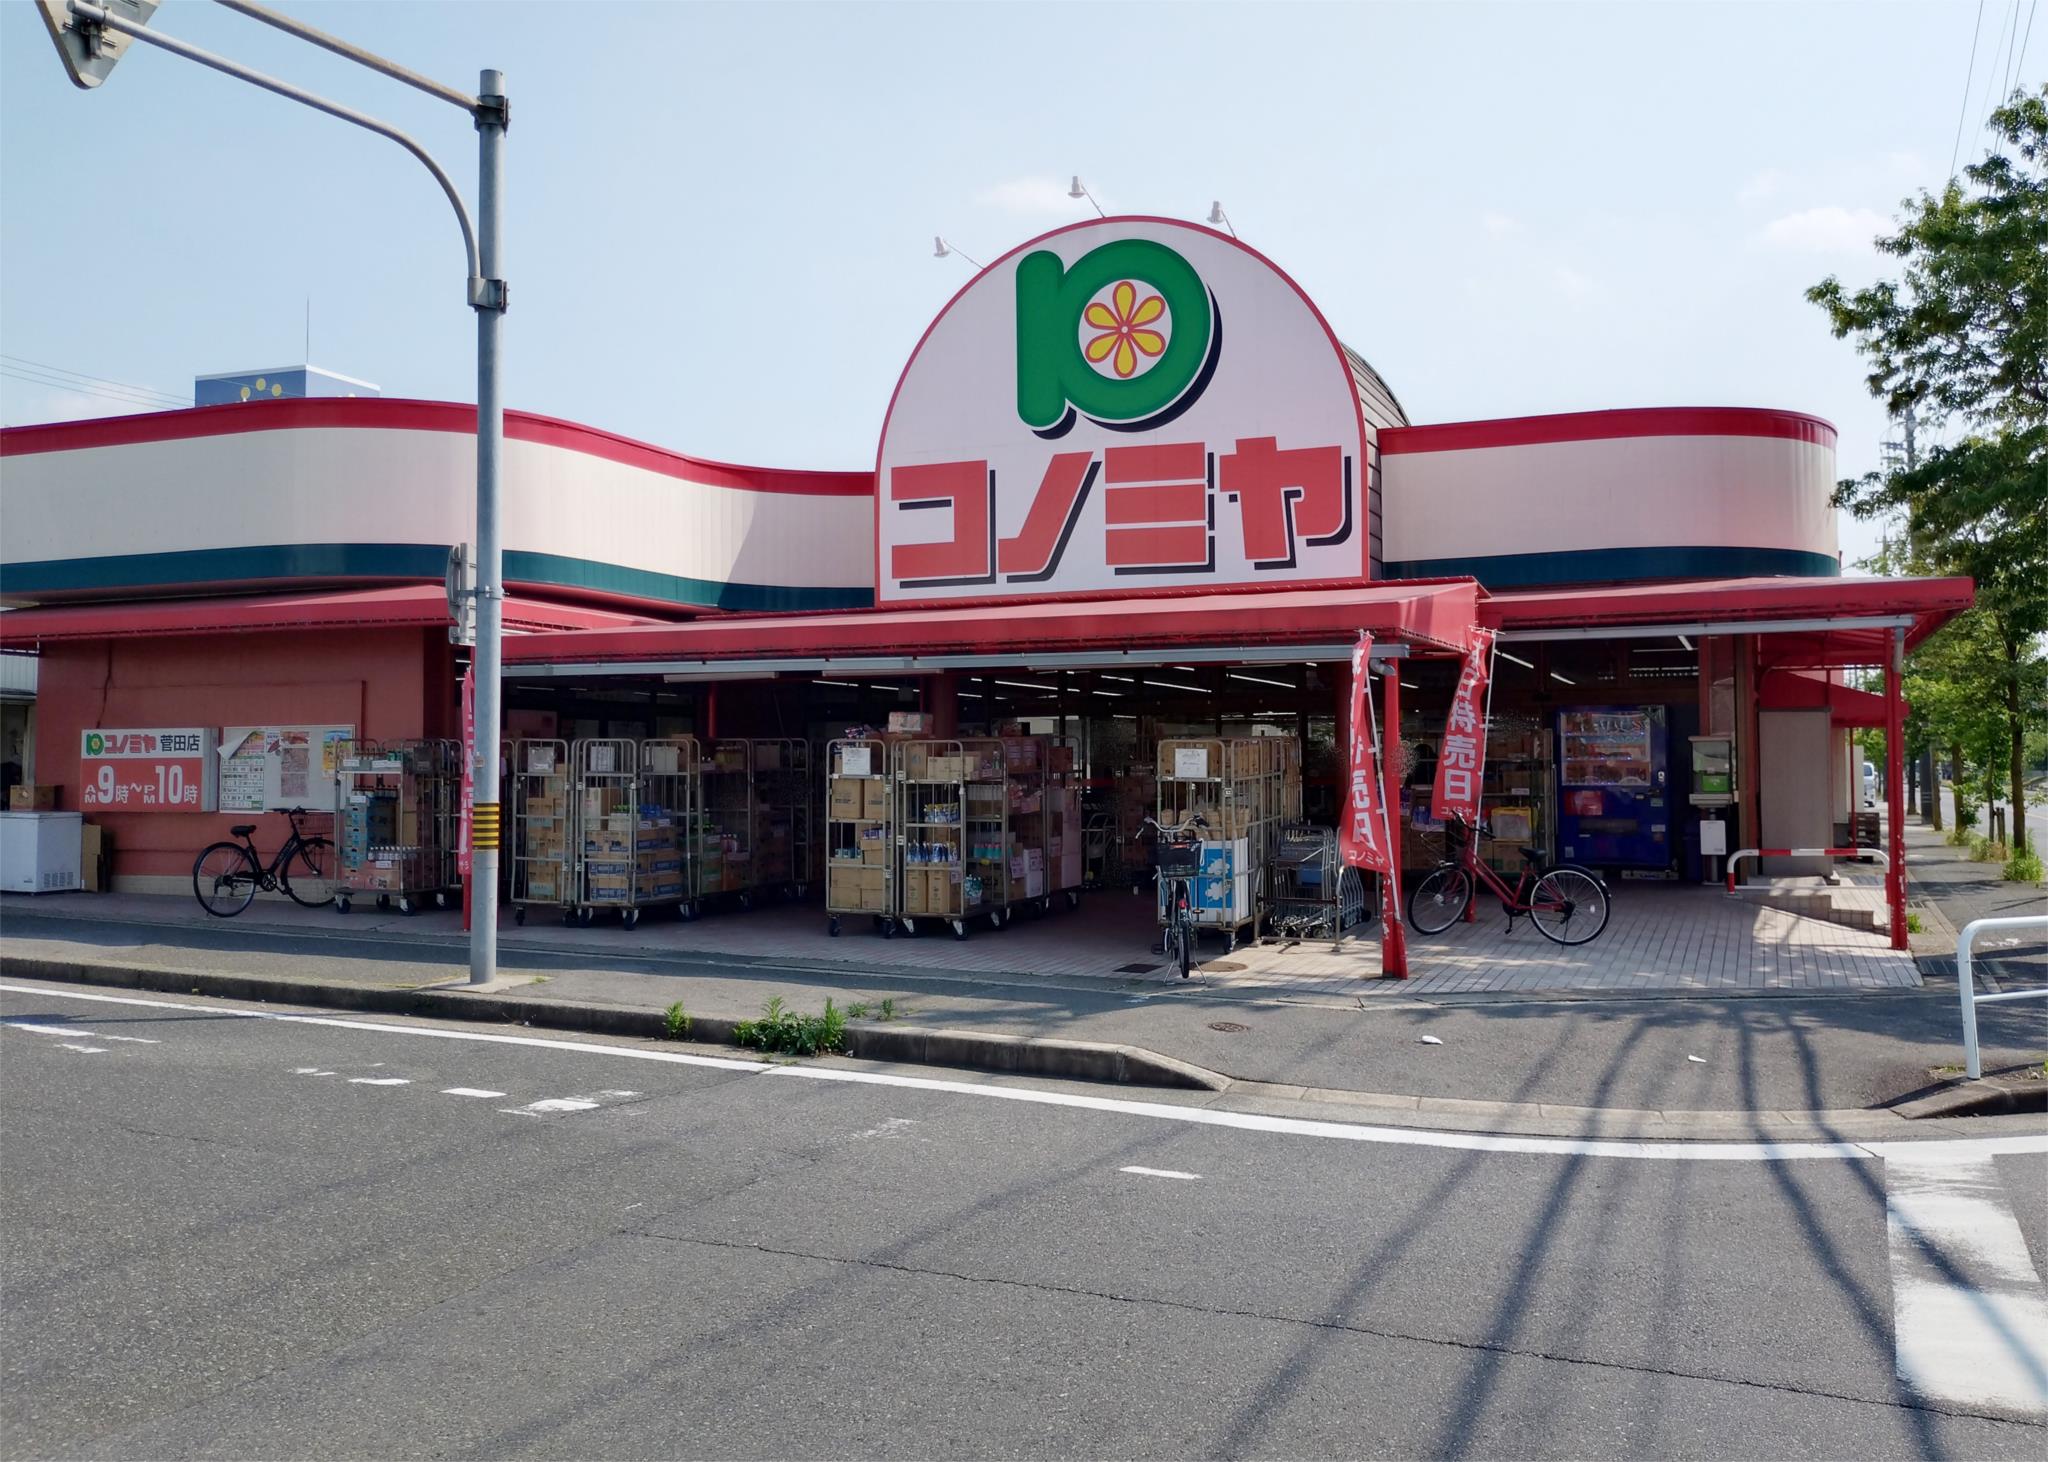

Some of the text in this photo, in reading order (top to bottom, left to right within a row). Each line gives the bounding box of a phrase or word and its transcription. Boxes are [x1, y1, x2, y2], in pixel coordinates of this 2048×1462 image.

[891, 436, 1350, 587] コノミヤ
[104, 734, 200, 754] コノミヤ 菅田店
[1348, 849, 1385, 867] コノミヤ
